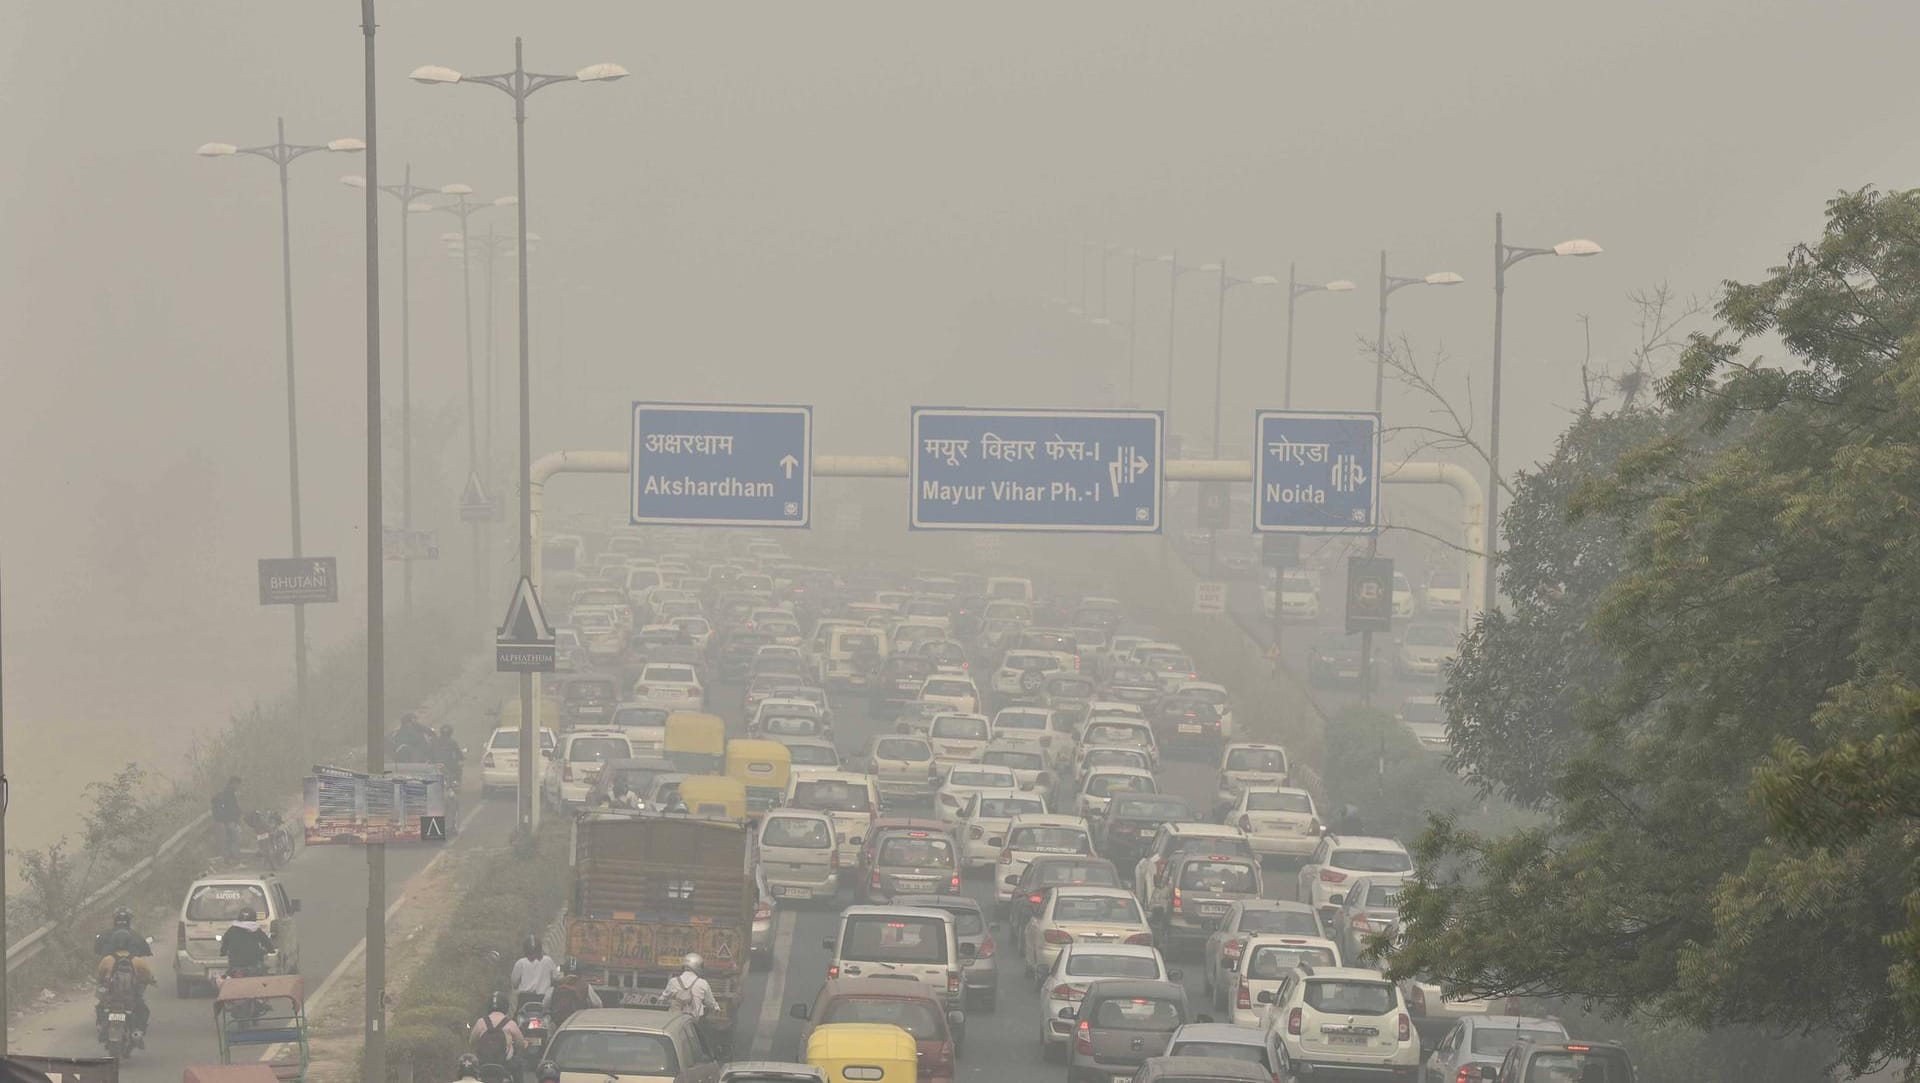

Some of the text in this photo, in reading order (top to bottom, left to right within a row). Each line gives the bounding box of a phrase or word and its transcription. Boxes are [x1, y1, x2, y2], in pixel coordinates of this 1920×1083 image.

[645, 434, 734, 455] अक्षरधाम
[924, 439, 970, 466] मयूर
[980, 432, 1036, 461] विहार
[1268, 434, 1330, 466] नोएडा
[644, 475, 774, 497] Akshardham
[923, 481, 985, 505] Mayur
[992, 482, 1045, 501] Vihar
[1266, 483, 1325, 504] Noida
[271, 575, 327, 591] BHUTANI
